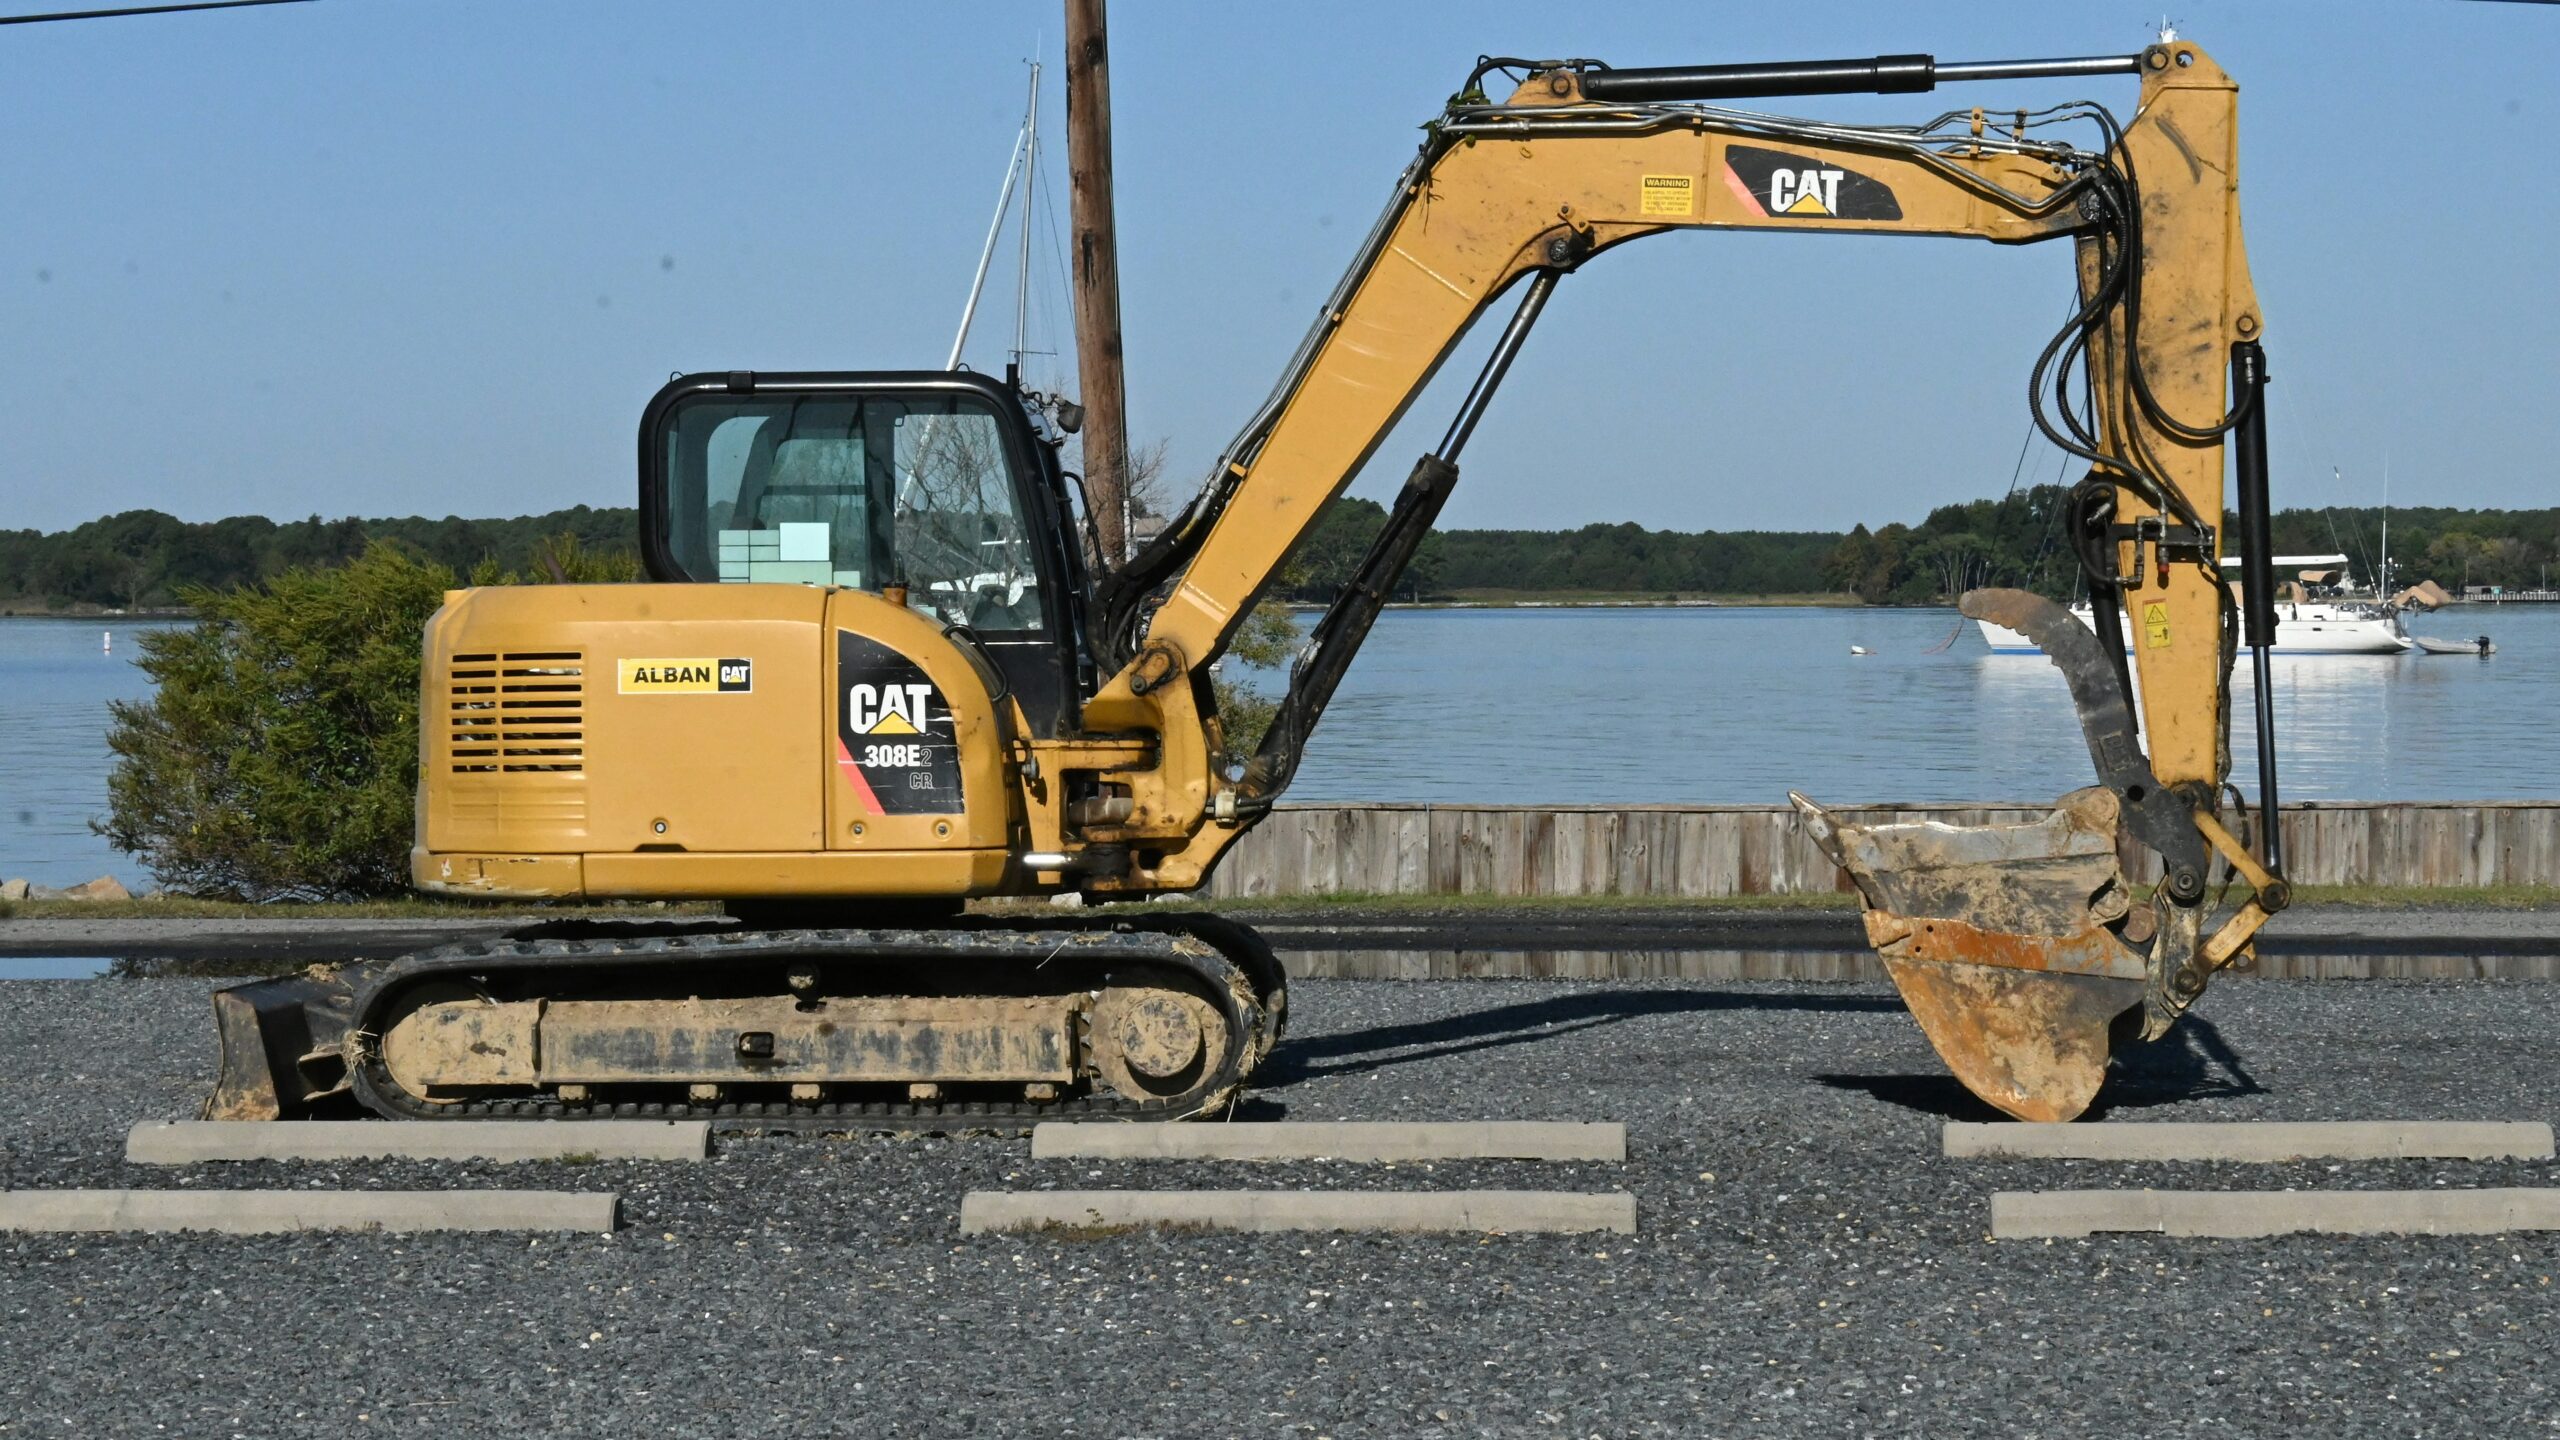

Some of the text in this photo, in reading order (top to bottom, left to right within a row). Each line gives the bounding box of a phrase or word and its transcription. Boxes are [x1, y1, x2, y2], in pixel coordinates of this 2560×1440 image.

[1646, 178, 1689, 188] WARNING
[1771, 168, 1844, 216] CAT
[634, 665, 748, 683] ALBAN CAT
[850, 684, 932, 735] CAT
[909, 772, 933, 790] CR
